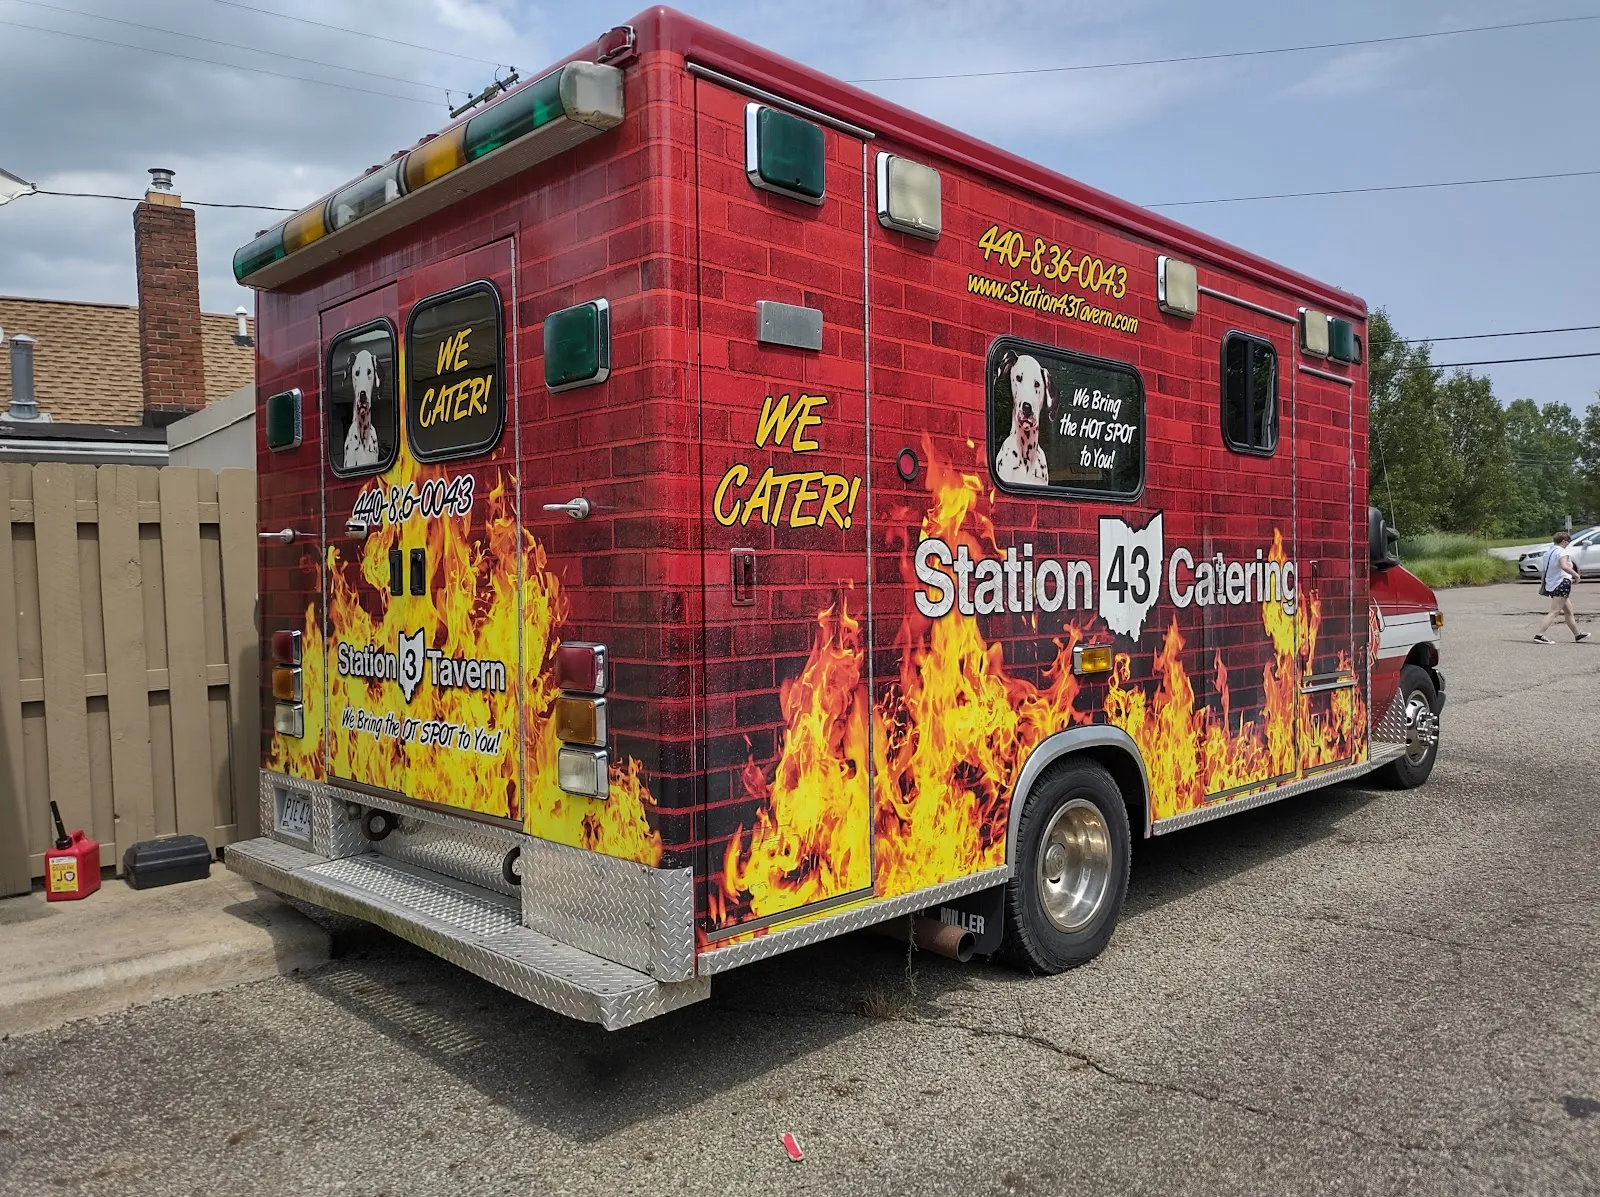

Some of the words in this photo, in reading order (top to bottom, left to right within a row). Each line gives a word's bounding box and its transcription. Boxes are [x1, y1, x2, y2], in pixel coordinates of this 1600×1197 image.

[978, 225, 1129, 299] 440-836-0043
[967, 273, 1139, 334] www.Station43Tavern.com
[436, 327, 474, 375] WE
[419, 374, 493, 428] CATER!
[755, 394, 828, 452] WE
[1073, 388, 1090, 409] We
[1092, 389, 1122, 420] Bring
[1060, 413, 1078, 436] the
[1079, 418, 1106, 440] HOT
[1104, 423, 1137, 444] SPOT
[1080, 445, 1092, 467] to
[1093, 447, 1116, 469] You!
[713, 463, 862, 529] CATER!
[914, 538, 1094, 618] Station
[1106, 545, 1152, 605] 43
[1168, 547, 1299, 615] Catering
[337, 641, 398, 680] Station
[427, 649, 506, 692] Tavern
[342, 708, 355, 728] We
[357, 709, 384, 741] Bring
[385, 712, 400, 738] the
[420, 723, 459, 747] SPOT
[458, 724, 471, 750] to
[474, 727, 503, 755] You!
[284, 798, 301, 821] PIE
[940, 906, 985, 935] MILLER
